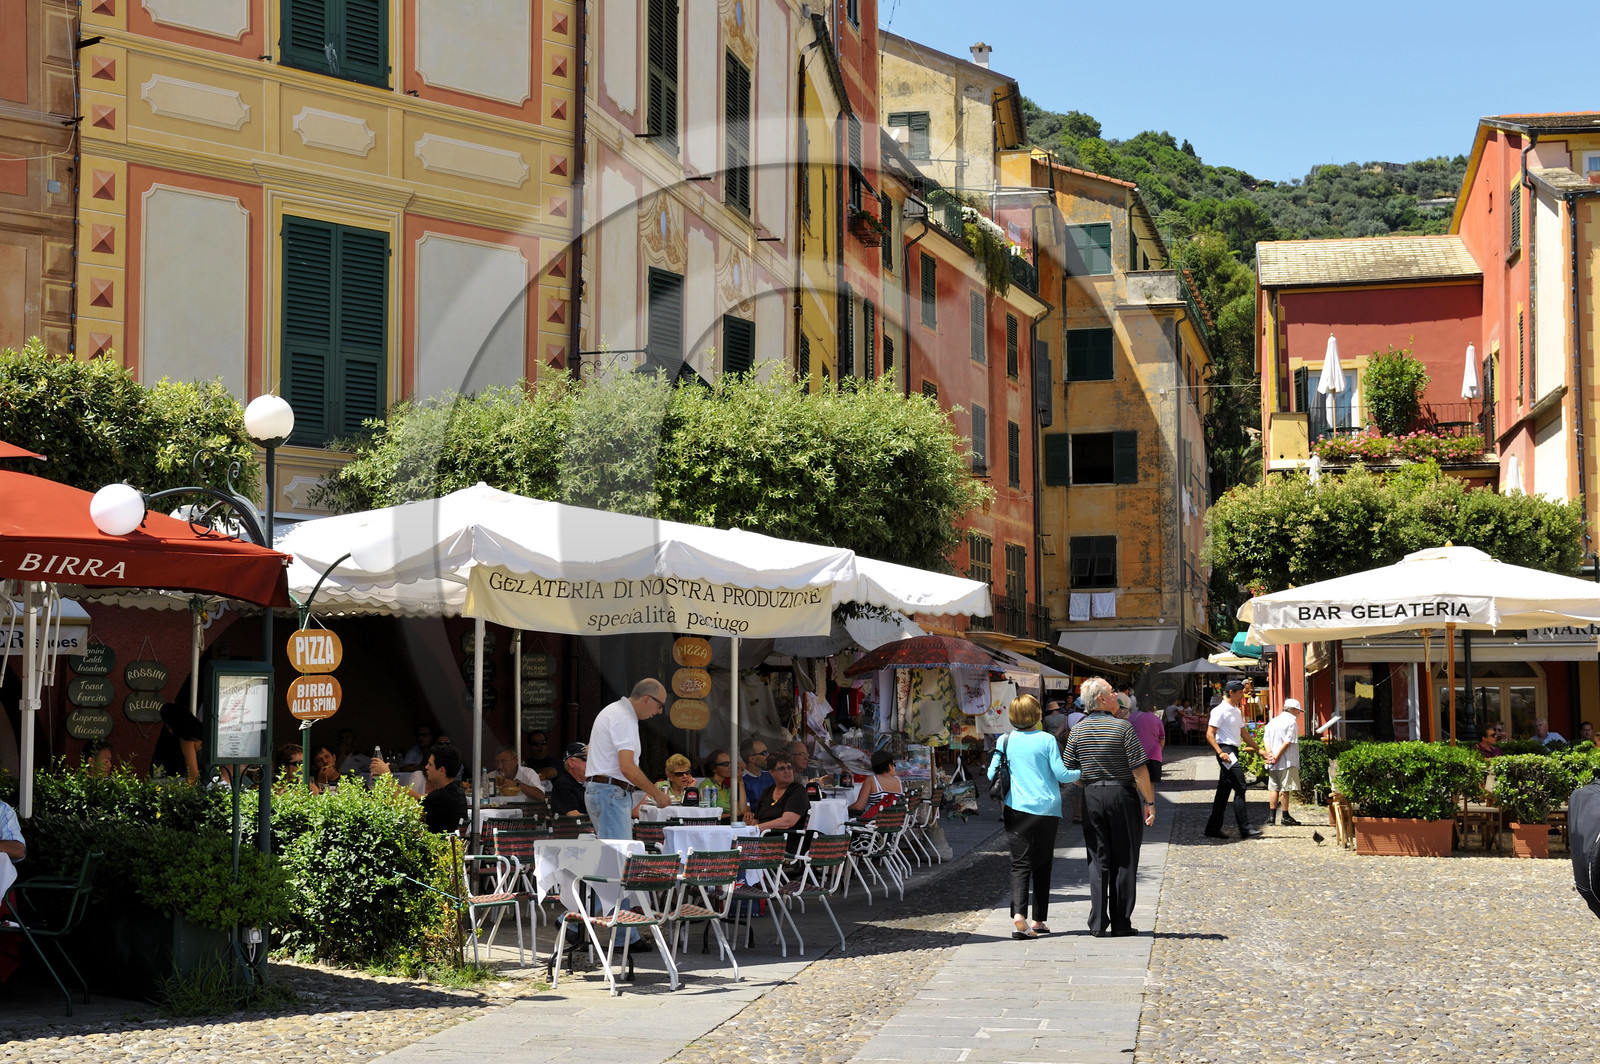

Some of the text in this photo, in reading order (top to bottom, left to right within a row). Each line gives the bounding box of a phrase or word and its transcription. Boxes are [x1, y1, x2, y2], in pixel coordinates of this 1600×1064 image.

[17, 553, 126, 579] BIRRA
[489, 571, 822, 608] GELATERIA DI NOSTRA PRODUZIONE
[1298, 601, 1471, 621] BAR GELATERIA
[587, 605, 749, 635] specialità paciugo
[86, 647, 106, 655] anini
[295, 635, 335, 666] PIZZA
[677, 643, 708, 660] PIZZA
[127, 668, 167, 681] ROSSINI
[80, 681, 104, 690] Toast
[296, 682, 333, 698] BIRRA
[76, 693, 107, 702] Farcito
[292, 697, 337, 713] ALLA SPINA
[128, 700, 164, 712] BELLINI
[72, 712, 108, 724] Caprese
